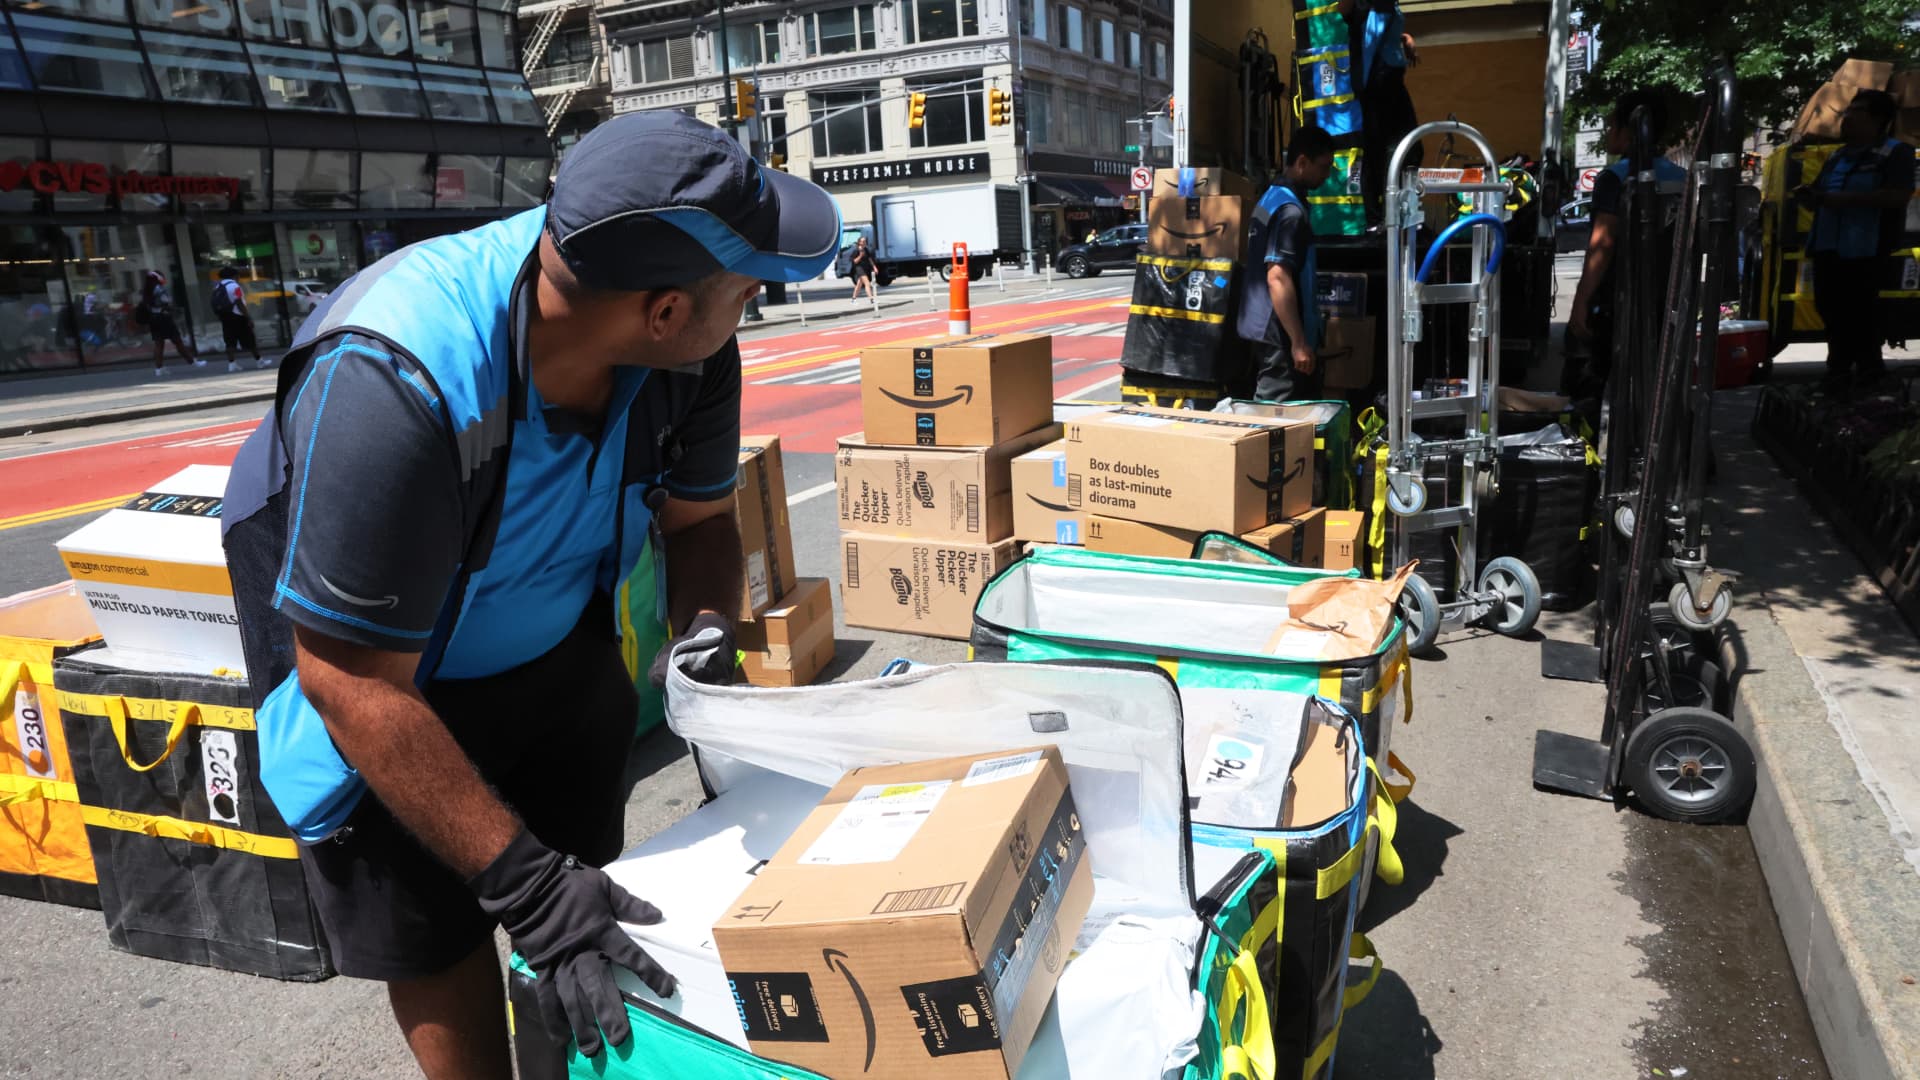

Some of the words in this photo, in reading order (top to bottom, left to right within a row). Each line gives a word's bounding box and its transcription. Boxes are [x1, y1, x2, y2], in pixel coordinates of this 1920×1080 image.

[28, 161, 111, 194] CVS
[116, 170, 239, 199] pharmacy
[823, 164, 912, 183] PERFORMIX
[924, 157, 975, 174] HOUSE
[1089, 458, 1110, 471] Box
[1113, 461, 1160, 479] doubles
[861, 480, 870, 522] Quicker
[912, 470, 935, 509] Bounty
[1089, 476, 1102, 488] as
[1104, 476, 1172, 498] last-minute
[1089, 491, 1136, 509] diorama
[853, 501, 861, 521] The
[871, 489, 880, 523] Picker
[880, 490, 891, 524] Upper
[896, 501, 904, 526] Quick
[904, 487, 912, 527] Livraison
[70, 561, 100, 574] amazon
[101, 563, 149, 577] commercial
[912, 547, 921, 588] Livraison
[920, 547, 928, 573] Quick
[936, 549, 946, 583] Upper
[947, 550, 957, 586] Picker
[957, 551, 968, 595] Quicker
[968, 552, 977, 574] The
[105, 593, 120, 601] PLUS
[889, 567, 912, 606] Bounty
[90, 599, 151, 616] MULTIFOLD
[152, 606, 189, 621] PAPER
[188, 610, 239, 626] TOWELS
[22, 708, 44, 750] 230
[761, 981, 771, 998] free
[767, 998, 781, 1032] delivery
[917, 992, 938, 1030] listening
[975, 985, 993, 1021] delivery
[933, 1030, 945, 1049] free
